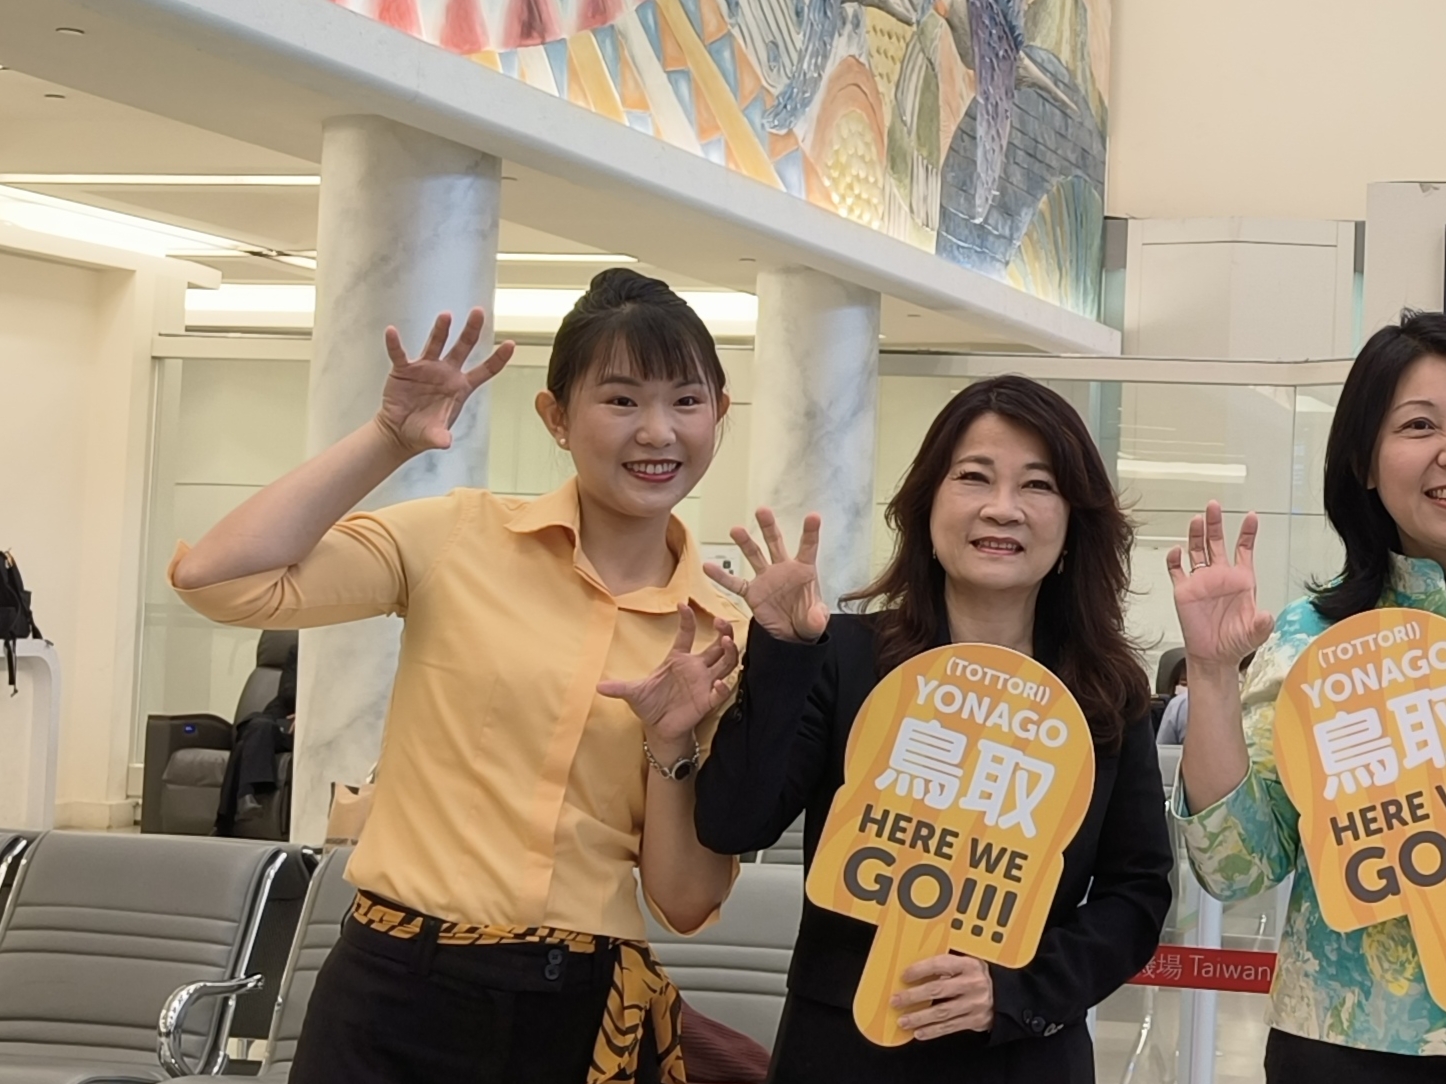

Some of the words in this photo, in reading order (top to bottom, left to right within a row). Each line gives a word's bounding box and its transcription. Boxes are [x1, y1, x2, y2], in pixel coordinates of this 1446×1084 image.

[1318, 621, 1421, 668] (TOTTORI)
[916, 675, 1068, 748] YONAGO
[946, 656, 1050, 705] (TOTTORI)
[874, 717, 1055, 838] 鳥取
[858, 803, 960, 861] HERE
[968, 837, 1029, 883] WE
[1329, 790, 1430, 846] HERE
[843, 846, 1018, 944] GO!!!
[1189, 955, 1270, 981] Taiwan
